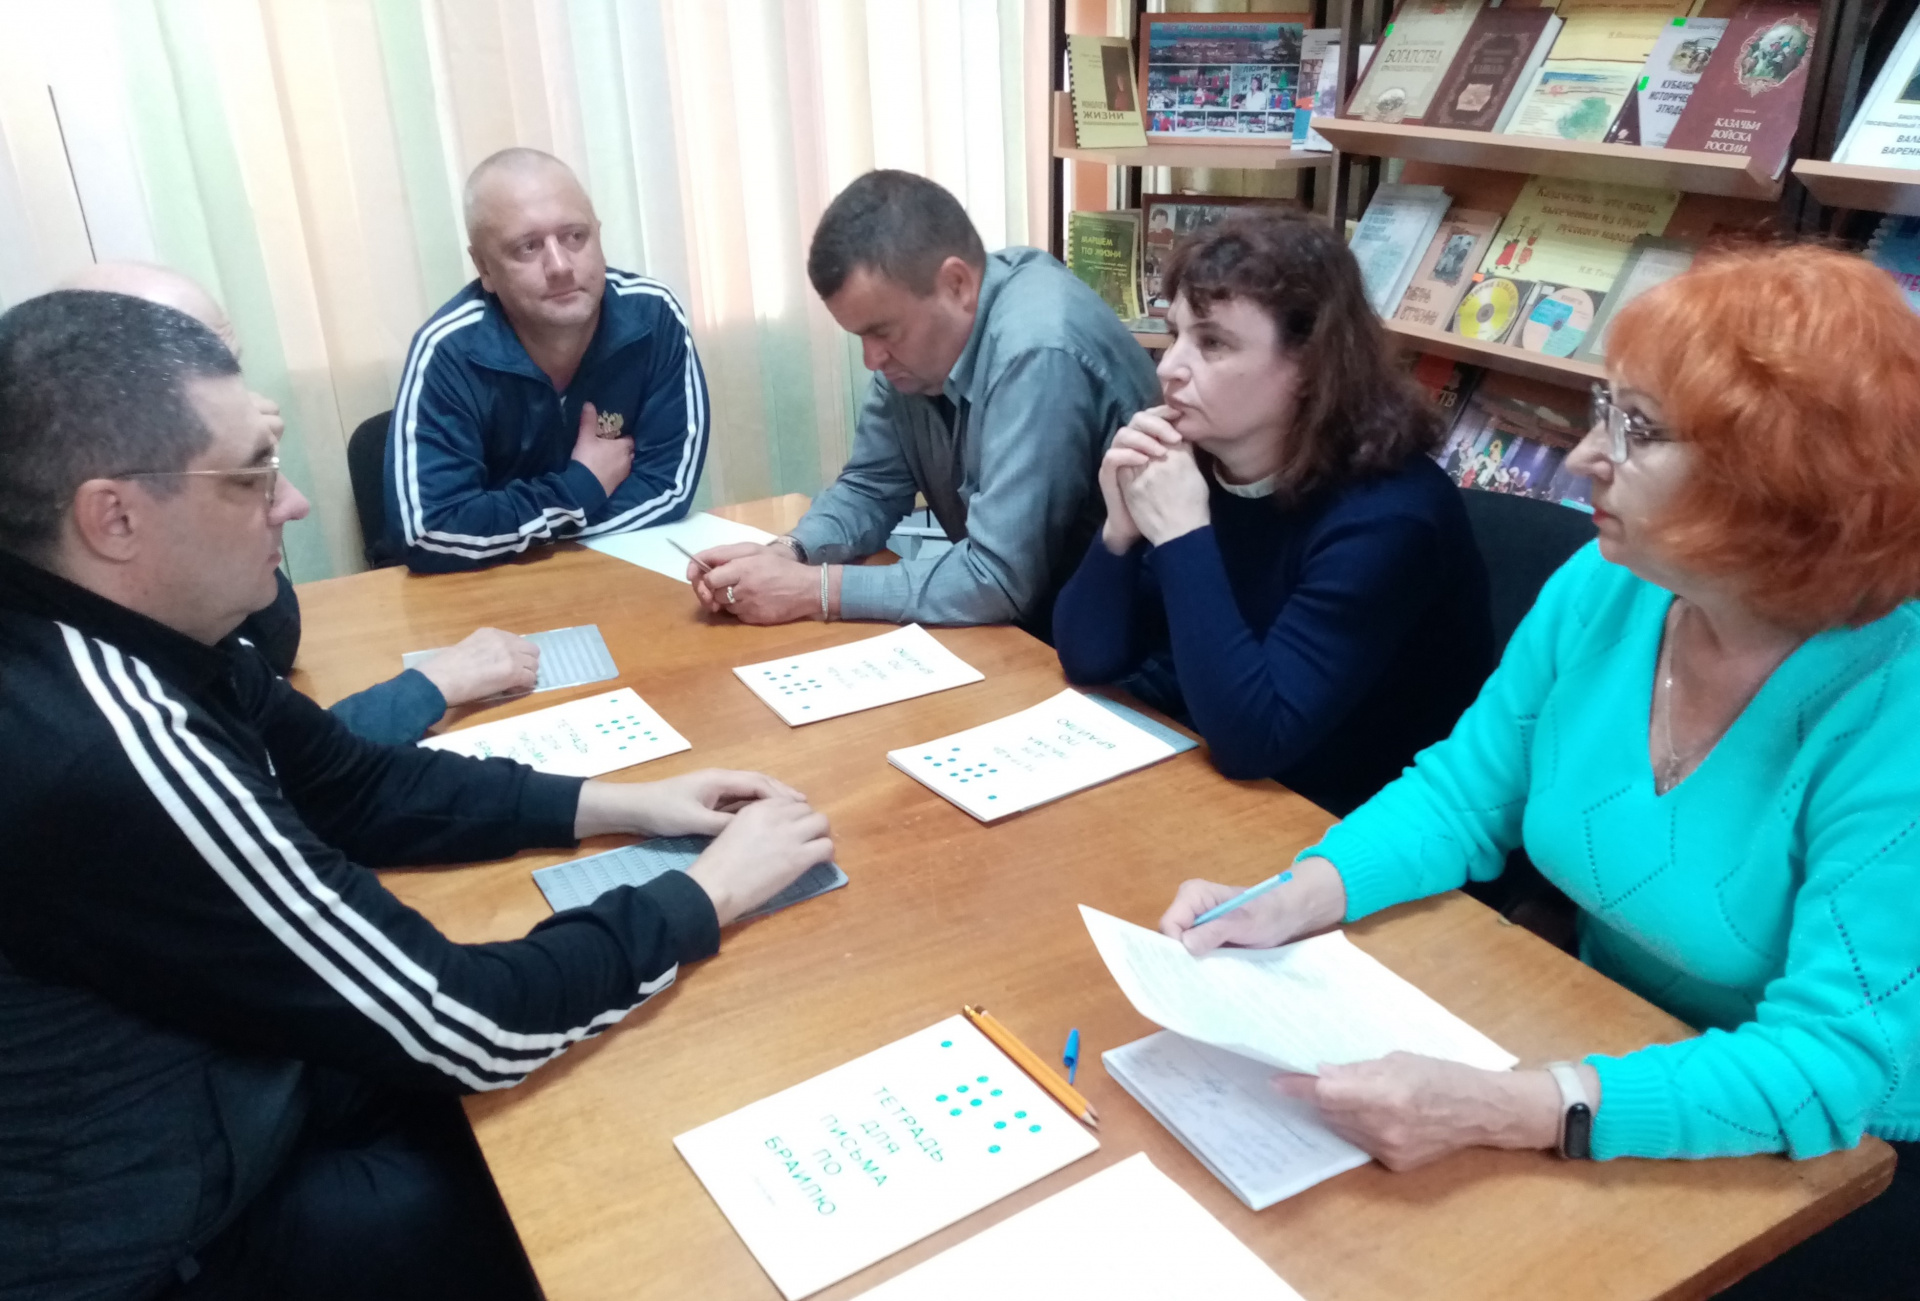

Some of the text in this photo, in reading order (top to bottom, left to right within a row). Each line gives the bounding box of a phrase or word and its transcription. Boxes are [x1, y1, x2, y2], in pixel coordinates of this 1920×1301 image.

[1385, 49, 1443, 64] БОГАТСТВА
[1083, 110, 1124, 120] ЖИЗНИ
[1714, 118, 1762, 131] КАЗАЧЬИ
[1710, 129, 1753, 142] ВОЙСКА
[1704, 140, 1749, 154] РОССИИ
[1081, 246, 1122, 259] ПО ЖИЗНИ
[873, 1085, 945, 1164] ТЕТРАДЬ
[857, 1119, 901, 1156] ДЛЯ
[819, 1113, 888, 1188] ПИСЬМА
[811, 1148, 843, 1176] ПО
